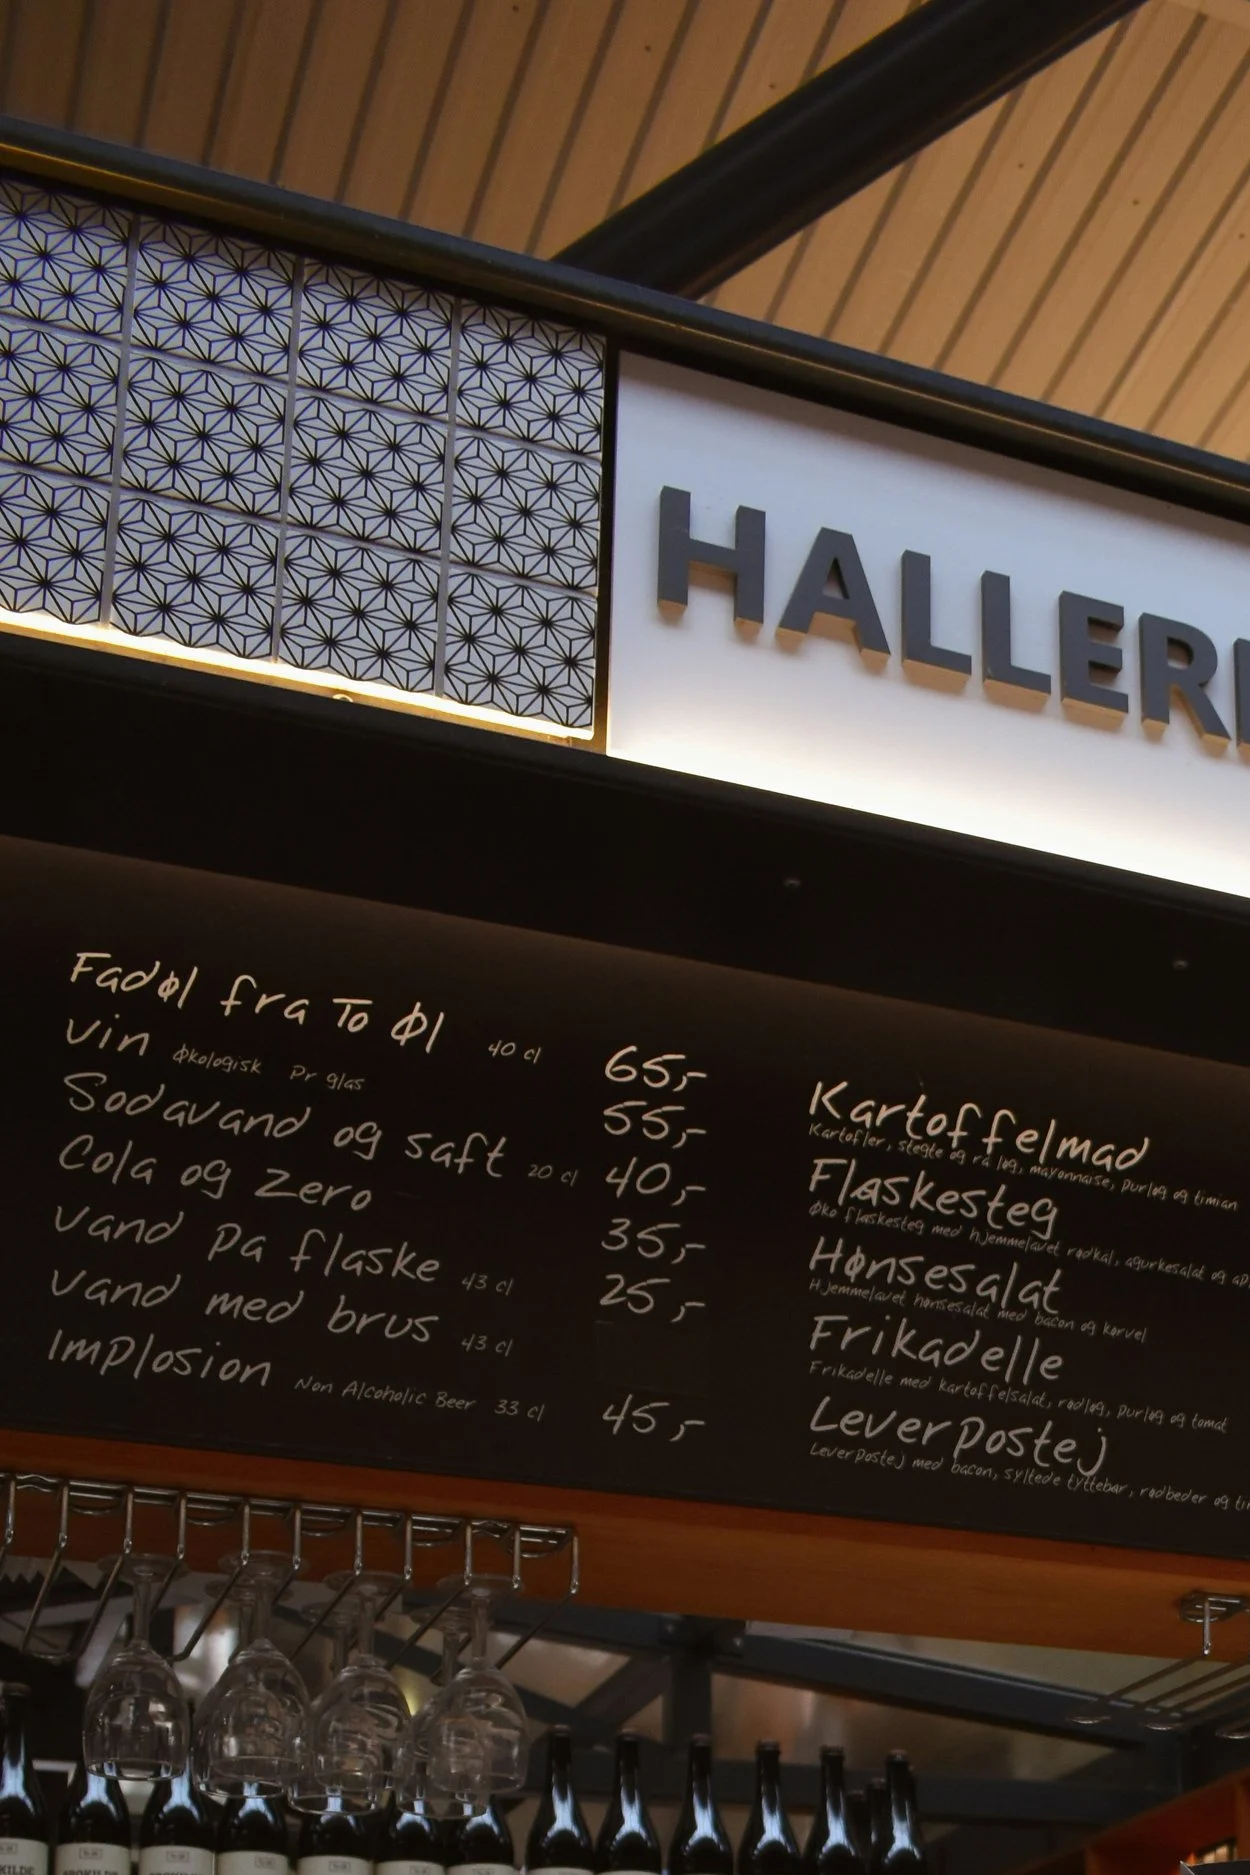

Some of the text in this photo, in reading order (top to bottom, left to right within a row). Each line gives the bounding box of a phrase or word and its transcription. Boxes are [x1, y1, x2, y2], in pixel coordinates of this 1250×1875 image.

[70, 952, 199, 1009] Fadøl
[219, 974, 310, 1025] fra
[332, 997, 373, 1033] To
[487, 1039, 517, 1057] 40
[523, 1047, 542, 1064] cl
[326, 1072, 365, 1091] glas
[62, 1072, 311, 1141] Sodavand
[333, 1121, 383, 1161] og
[404, 1131, 507, 1178] saft
[527, 1163, 553, 1180] 20
[809, 1080, 1150, 1172] Kartoffelmad
[58, 1134, 157, 1185] Cola
[180, 1159, 232, 1200] og
[898, 1139, 944, 1159] stegte
[949, 1149, 967, 1165] og
[1172, 1188, 1189, 1204] og
[1193, 1190, 1238, 1211] timian
[289, 1228, 440, 1282] flaske
[461, 1272, 488, 1291] 43
[809, 1236, 1064, 1315] Hønsesalat
[931, 1224, 963, 1238] med
[1124, 1255, 1205, 1281] agurkesalat
[1210, 1269, 1227, 1285] og
[204, 1289, 305, 1324] med
[326, 1294, 440, 1343] brus
[460, 1333, 488, 1352] 43
[809, 1314, 1064, 1387] Frikadelle
[997, 1309, 1028, 1322] med
[1034, 1311, 1075, 1330] bacon
[1080, 1320, 1097, 1336] og
[341, 1380, 427, 1406] Alcoholic
[435, 1391, 477, 1410] Beer
[494, 1399, 520, 1416] 33
[809, 1360, 894, 1386] Frikadelle
[899, 1375, 932, 1389] med
[1170, 1412, 1186, 1428] og
[1191, 1413, 1228, 1433] tomat
[911, 1457, 944, 1471] med
[1004, 1467, 1061, 1486] syltede
[1213, 1494, 1230, 1511] og
